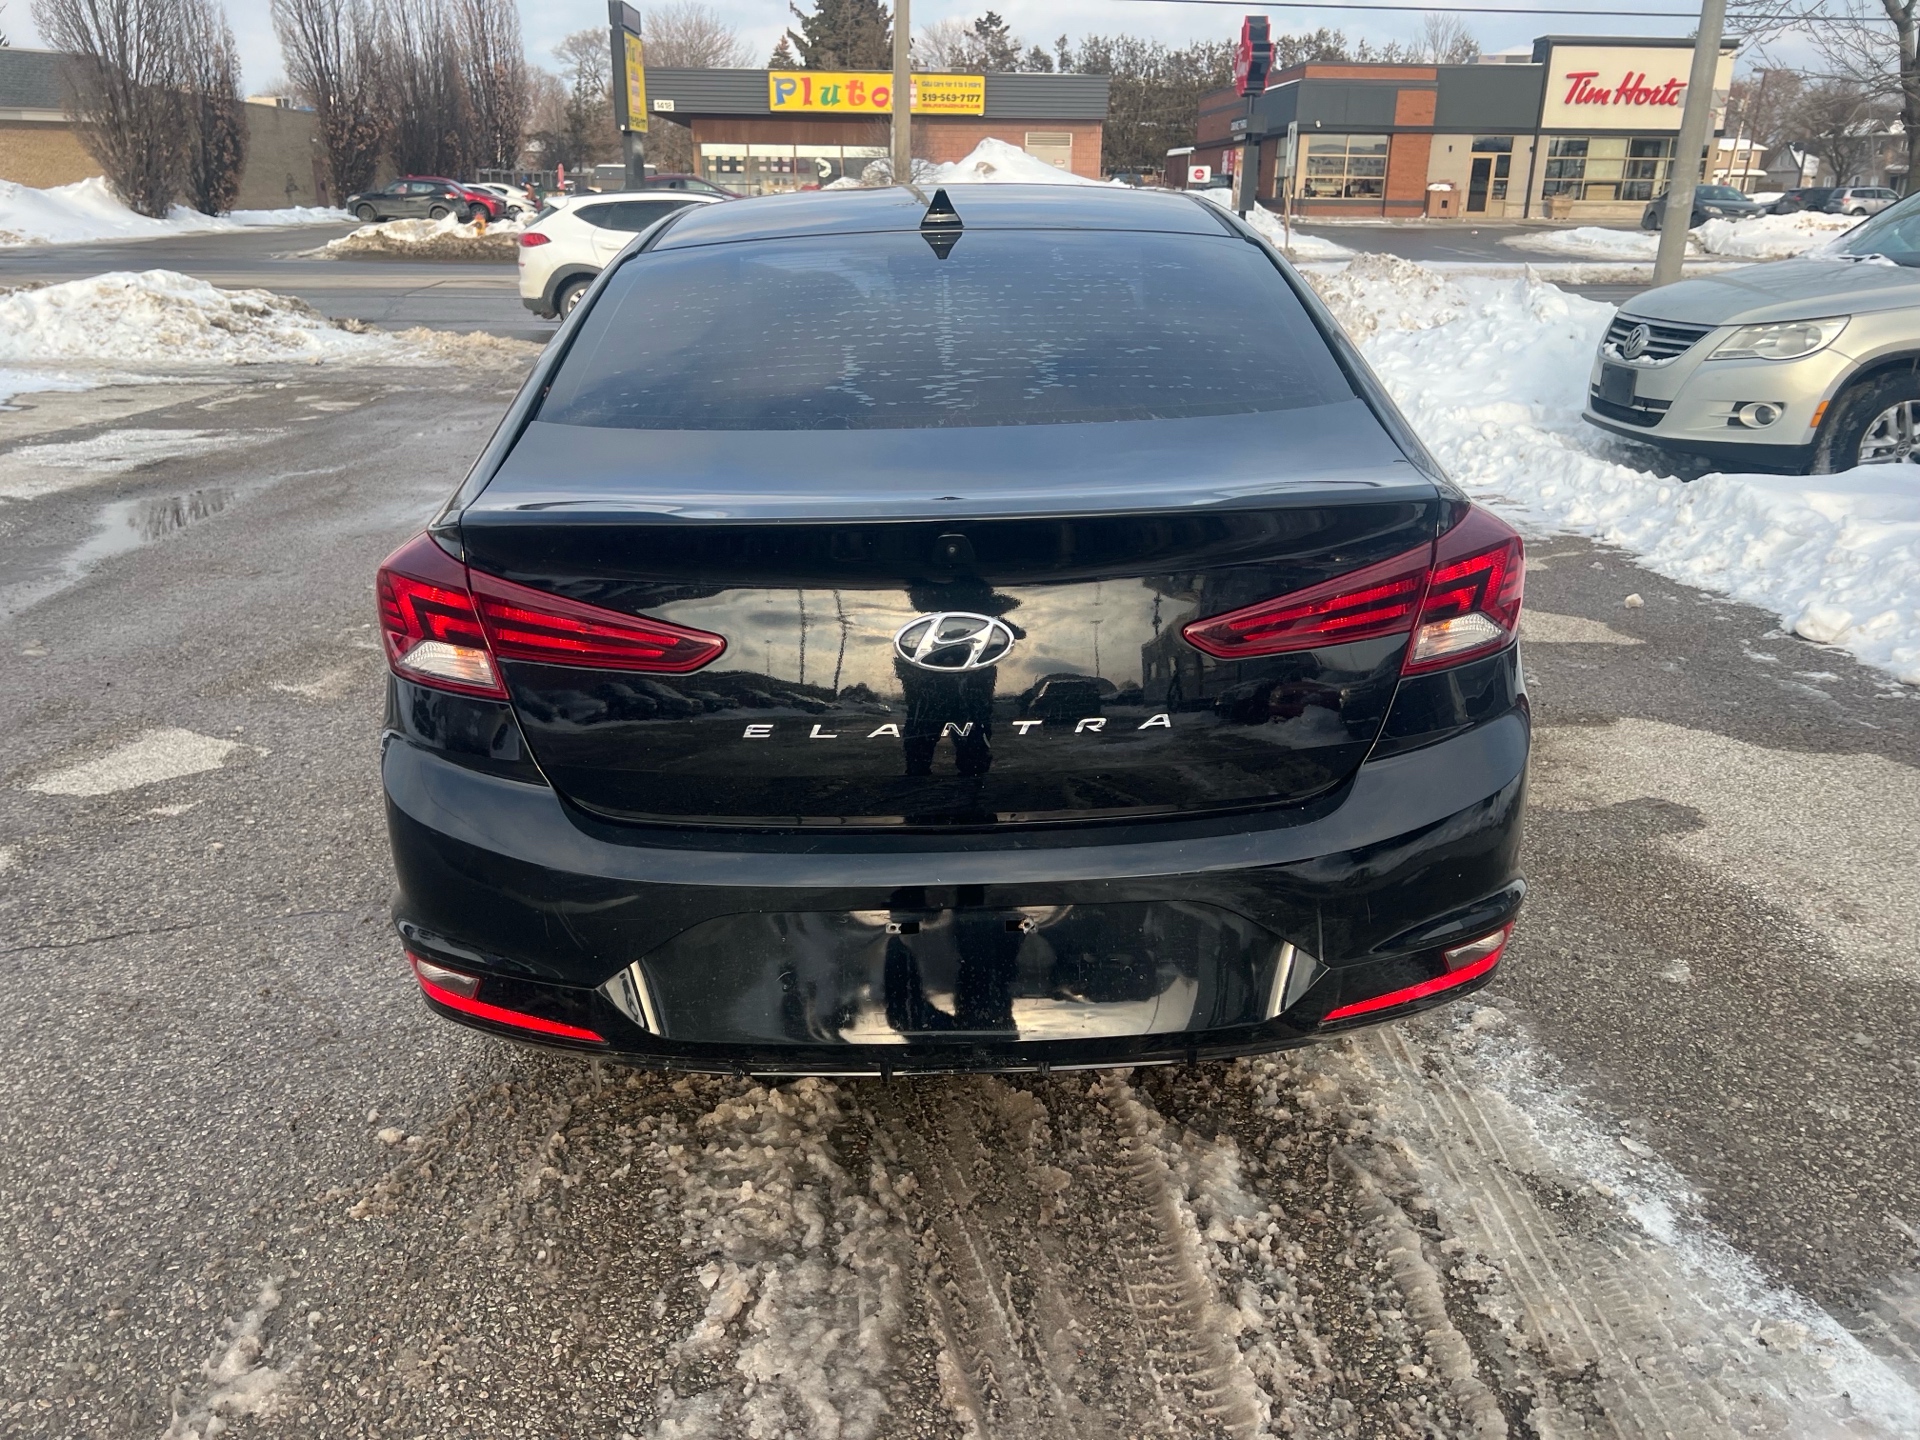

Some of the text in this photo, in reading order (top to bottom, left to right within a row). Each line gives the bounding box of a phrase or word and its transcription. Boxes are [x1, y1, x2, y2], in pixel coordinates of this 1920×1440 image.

[773, 76, 890, 108] Pluto
[922, 93, 981, 103] 519-569-7177
[1564, 71, 1612, 106] Tim
[743, 713, 1172, 737] ELANTRA
